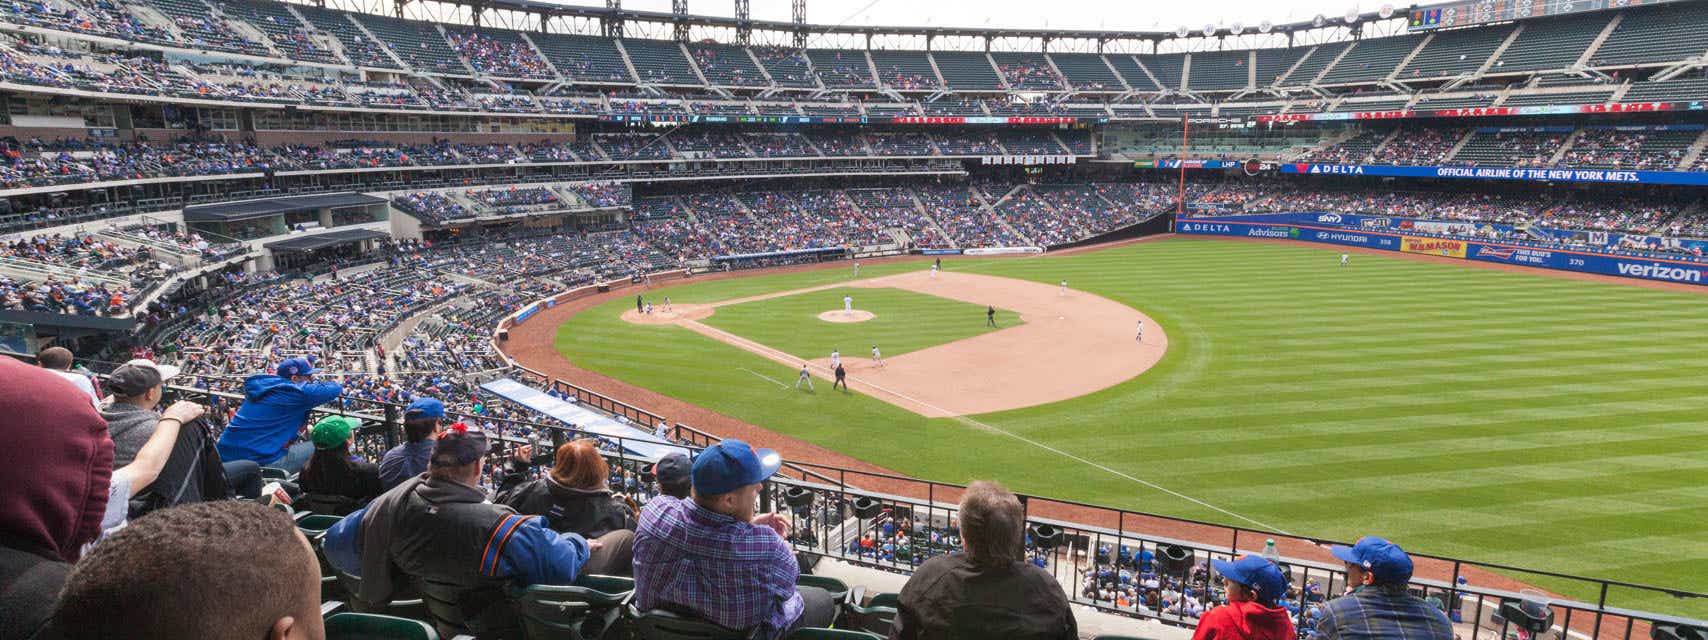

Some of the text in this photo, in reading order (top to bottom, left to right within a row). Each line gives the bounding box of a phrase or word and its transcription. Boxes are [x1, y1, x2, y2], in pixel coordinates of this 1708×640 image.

[1323, 165, 1364, 174] DELTA
[1437, 167, 1640, 181] OFFICIAL AIRLINE OF THE NEW YORK METS.
[1318, 214, 1342, 223] SNY
[1194, 224, 1230, 232] DELTA
[1248, 228, 1289, 238] Advisors
[1330, 233, 1368, 243] HYUNDAI
[1568, 258, 1585, 266] 370
[1617, 262, 1701, 282] verizon
